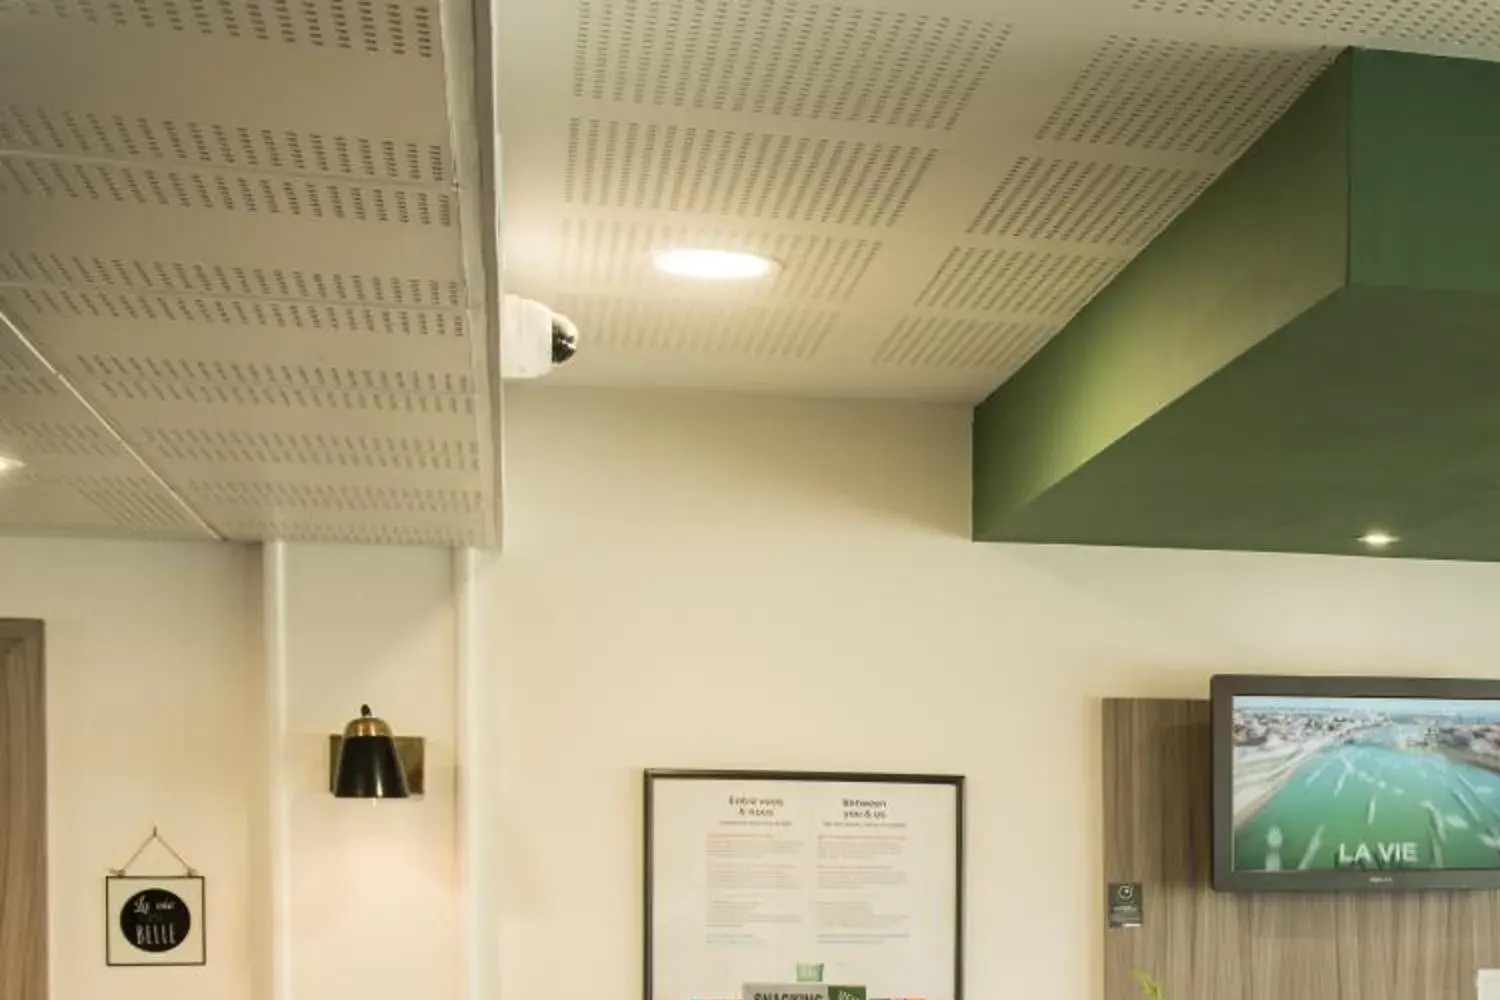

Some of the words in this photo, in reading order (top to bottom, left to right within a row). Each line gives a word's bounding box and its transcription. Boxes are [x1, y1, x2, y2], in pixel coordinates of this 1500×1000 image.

[1339, 842, 1372, 863] LA
[1377, 842, 1418, 863] VIE
[135, 922, 176, 945] BELLE
